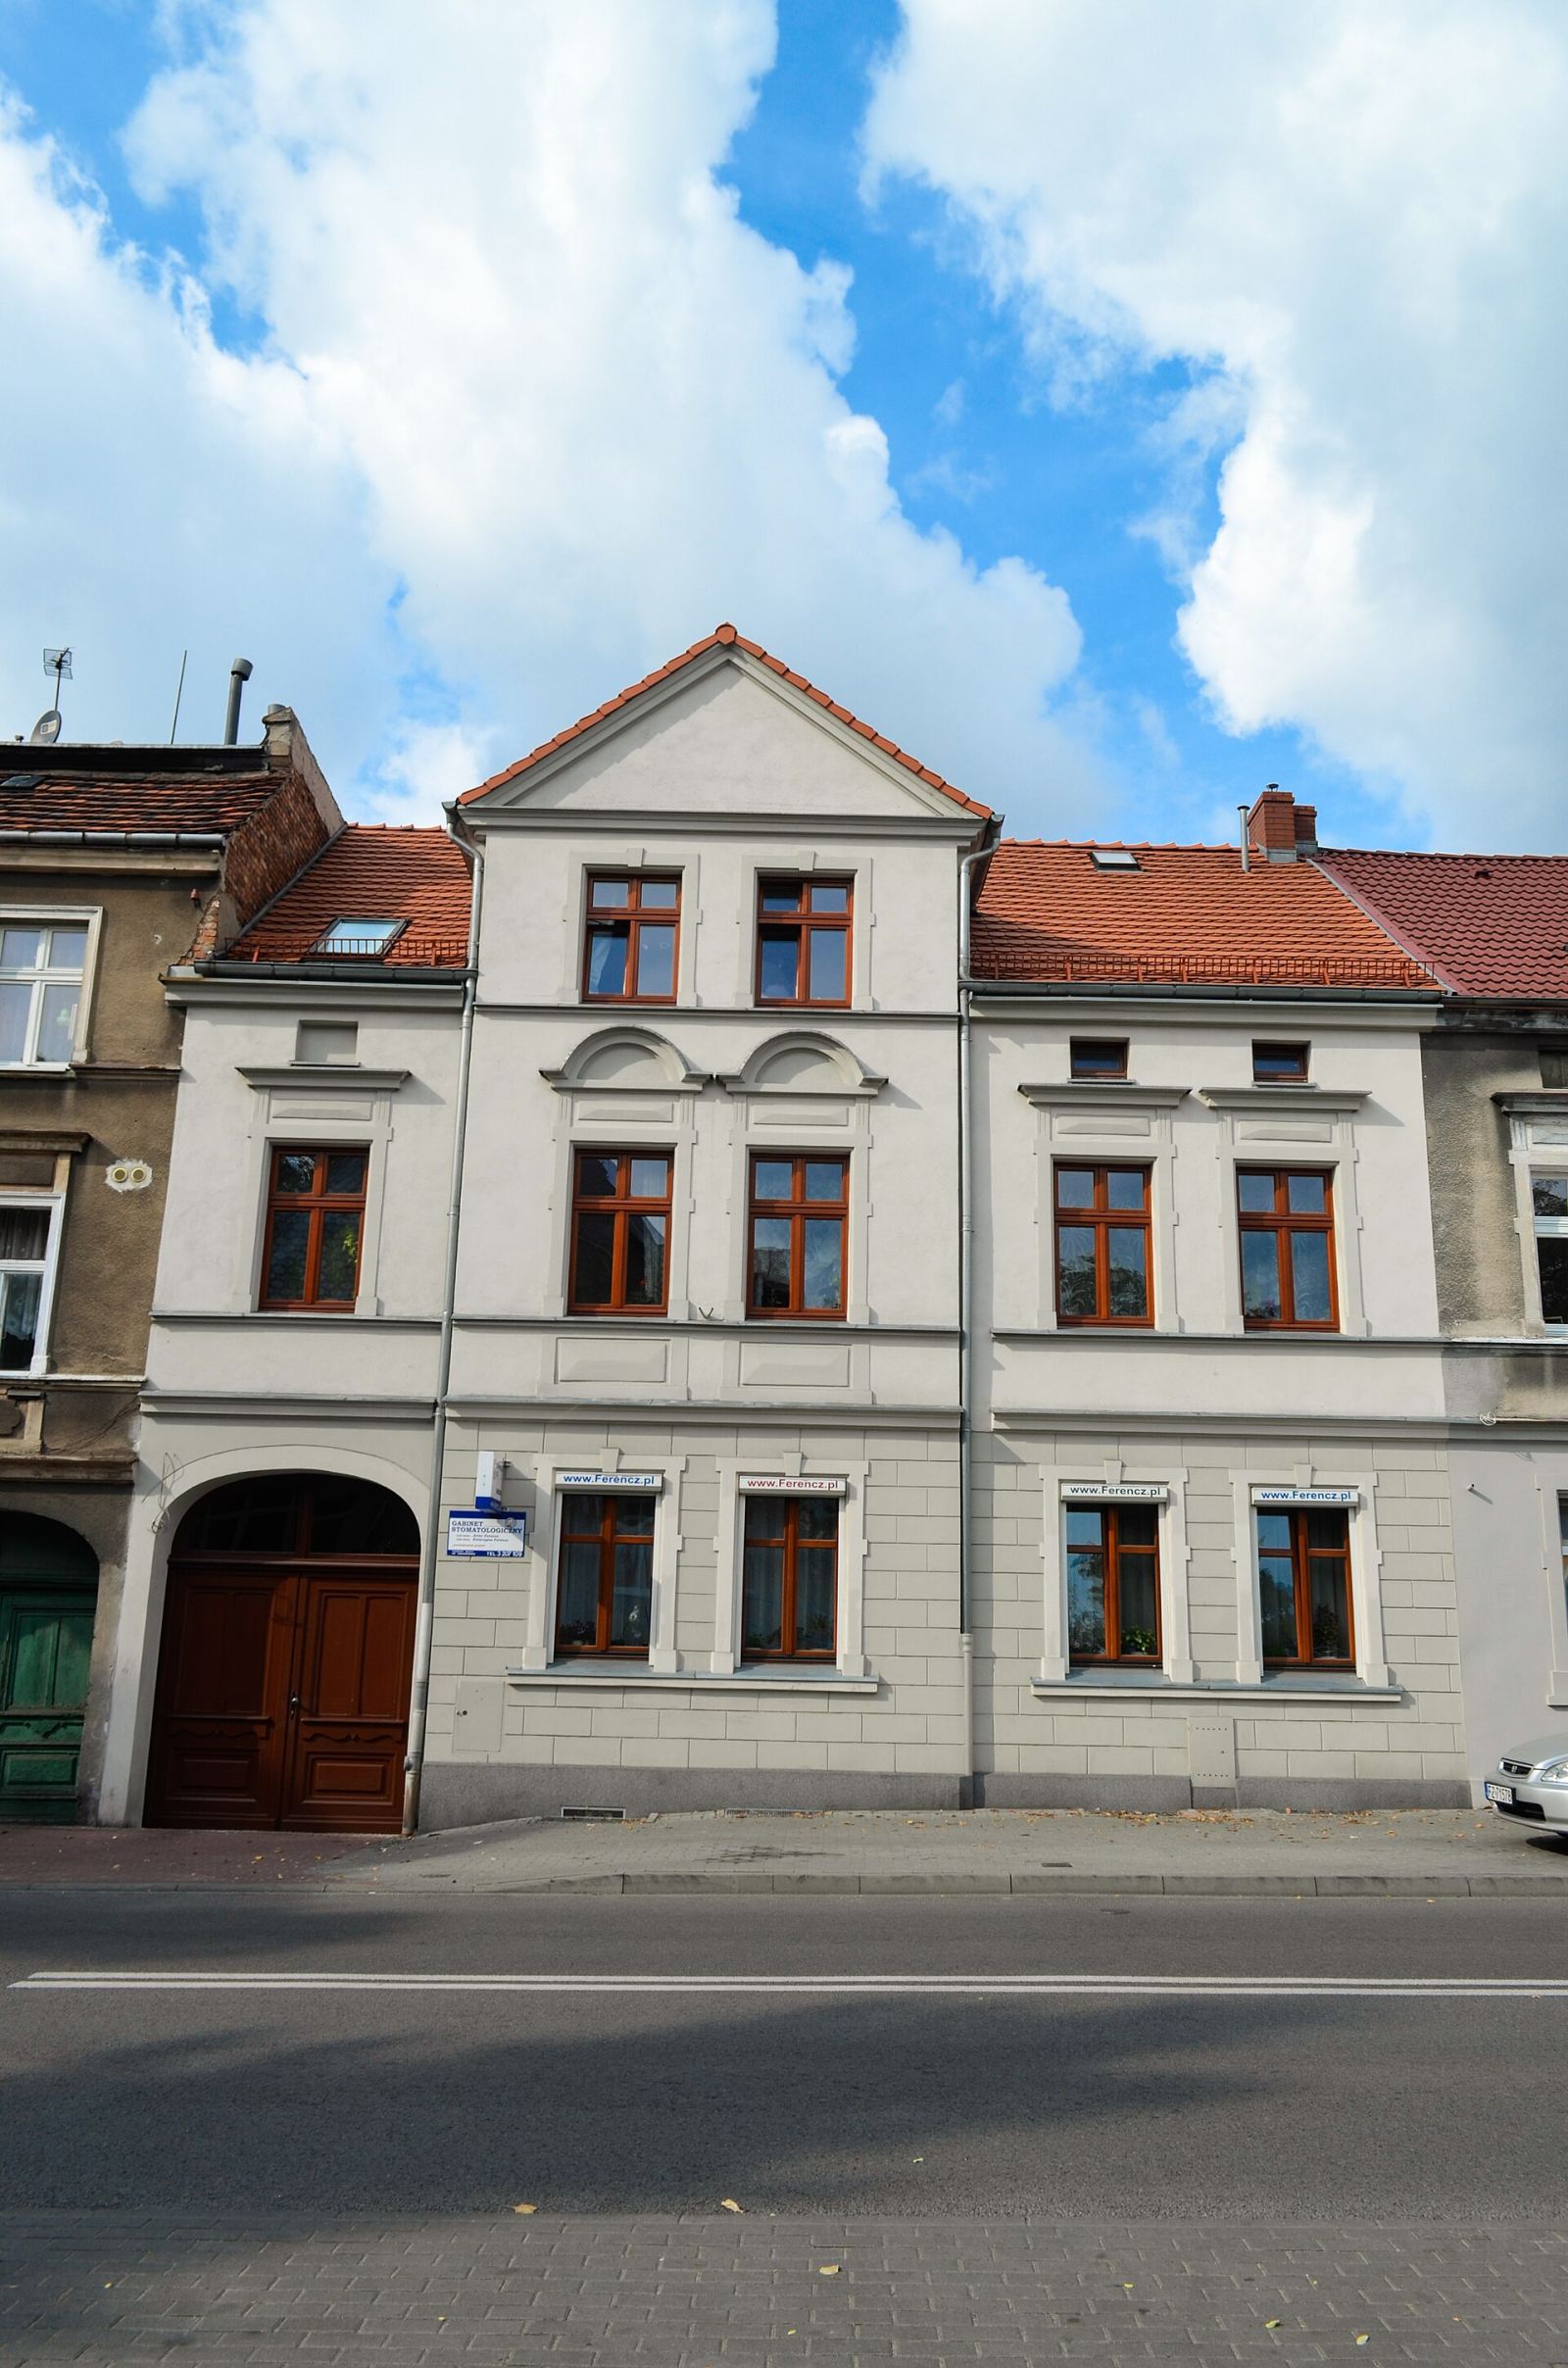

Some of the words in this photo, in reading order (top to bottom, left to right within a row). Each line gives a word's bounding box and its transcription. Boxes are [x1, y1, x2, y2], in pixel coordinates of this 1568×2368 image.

[564, 1474, 655, 1486] www.Ferencz.pl
[747, 1478, 838, 1490] www.Ferencz.pl
[1070, 1485, 1160, 1497] www.Ferencz.pl
[1261, 1490, 1351, 1502] www.Ferencz.pl
